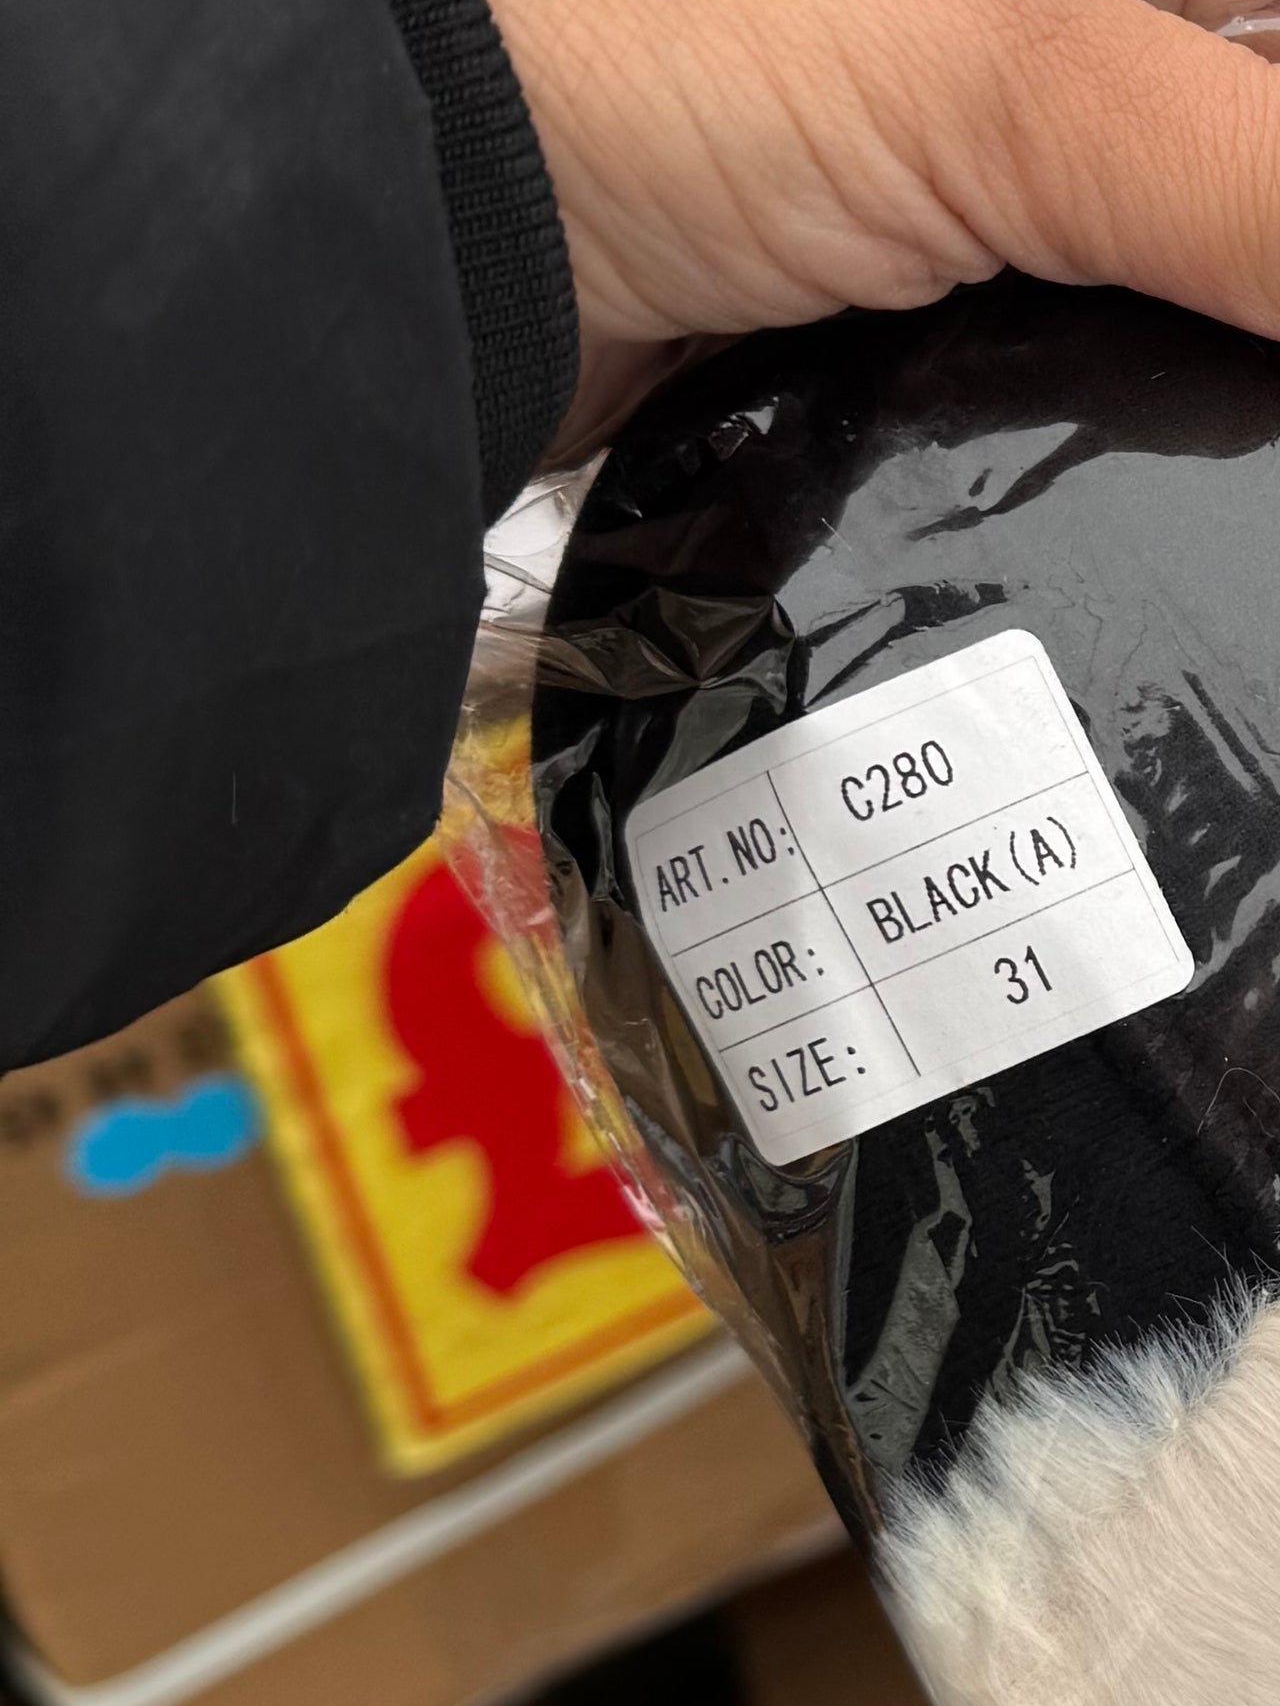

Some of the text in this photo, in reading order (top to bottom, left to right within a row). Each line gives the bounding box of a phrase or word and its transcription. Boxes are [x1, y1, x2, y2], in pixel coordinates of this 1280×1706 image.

[840, 739, 954, 822] C280
[695, 940, 825, 1021] COLOR:
[747, 945, 1053, 1113] SIZE: 31
